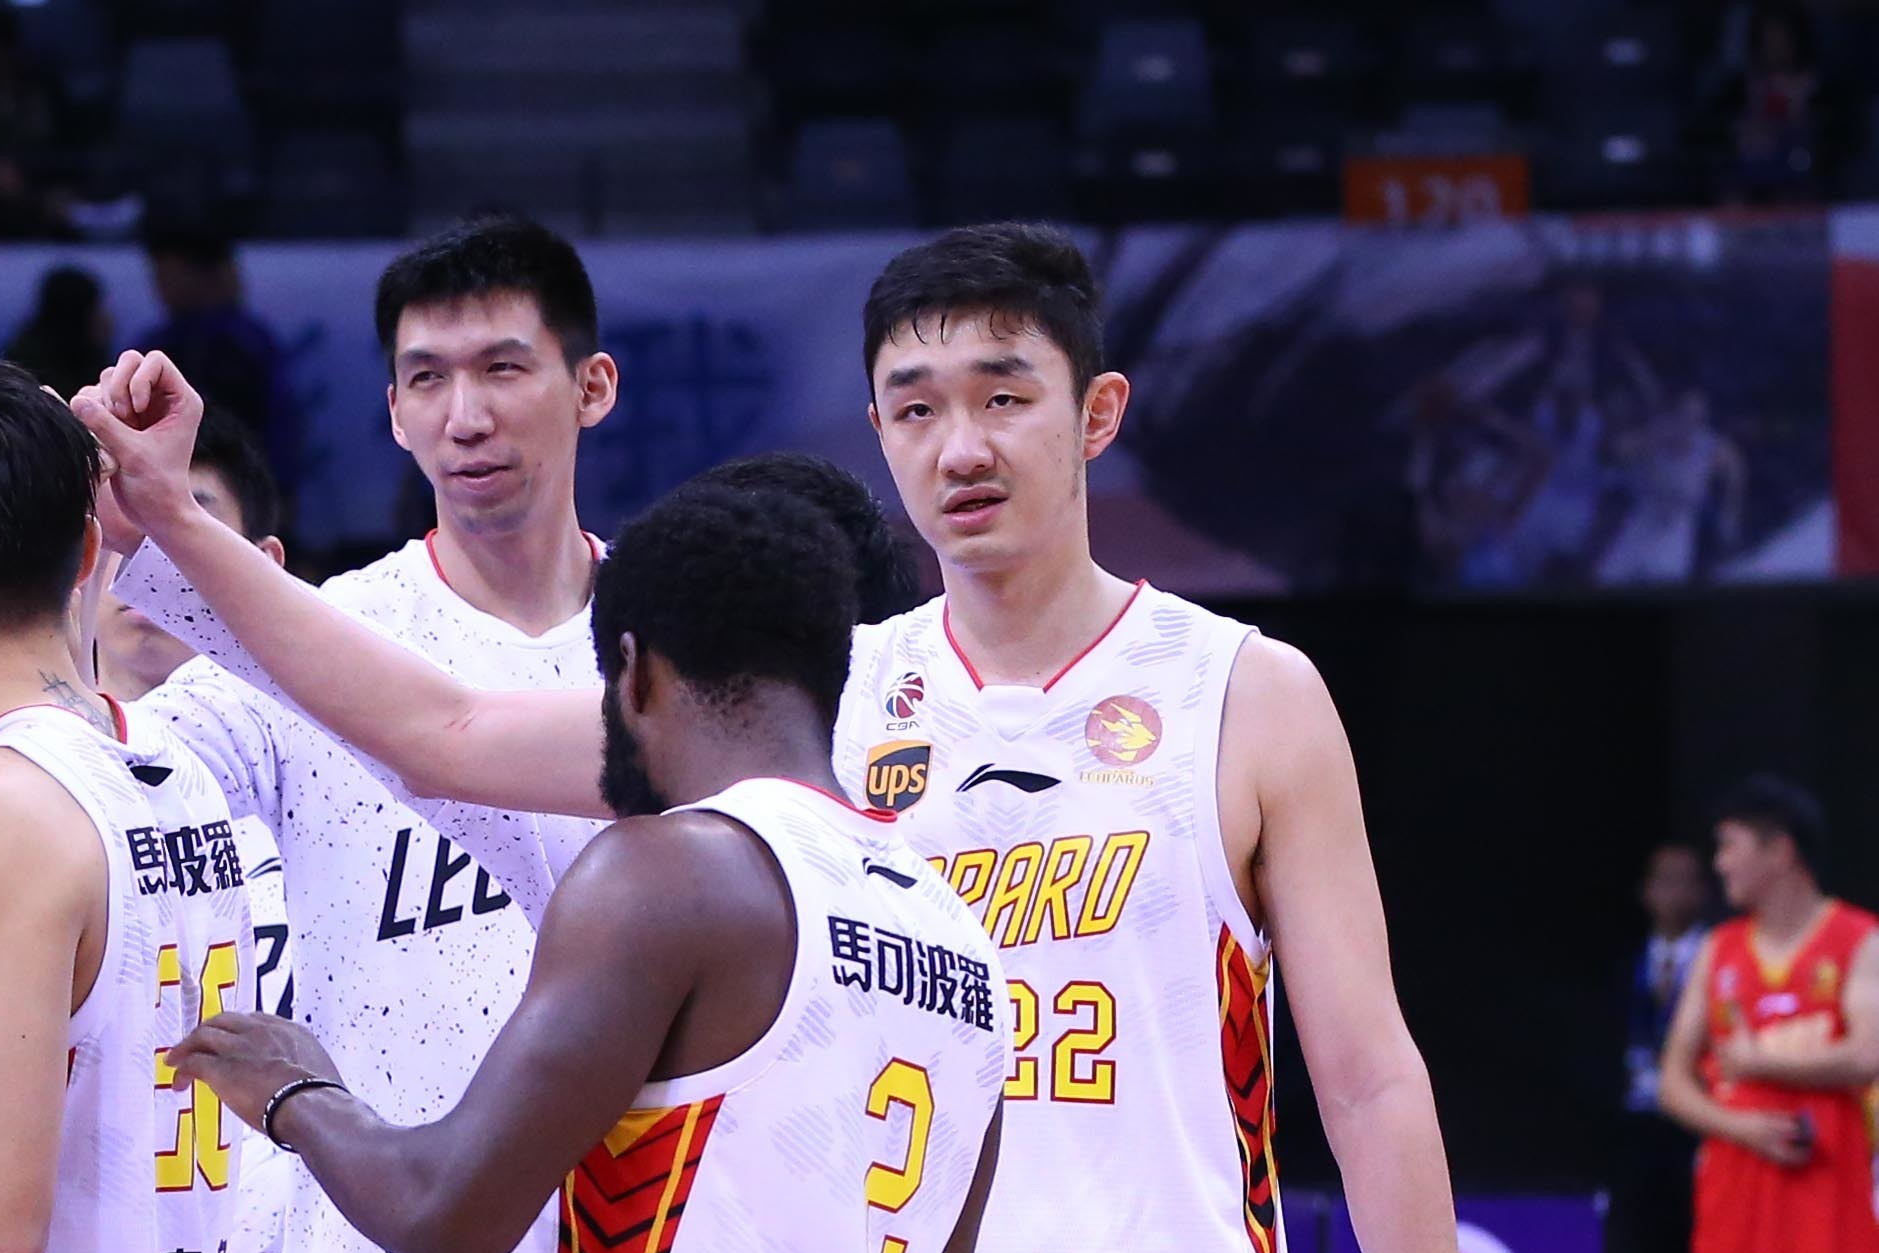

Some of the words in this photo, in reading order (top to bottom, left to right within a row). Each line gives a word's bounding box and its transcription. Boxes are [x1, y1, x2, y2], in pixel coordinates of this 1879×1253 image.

[869, 763, 927, 807] ups
[926, 831, 1151, 949] PARD
[826, 914, 994, 1033] 馬可波羅
